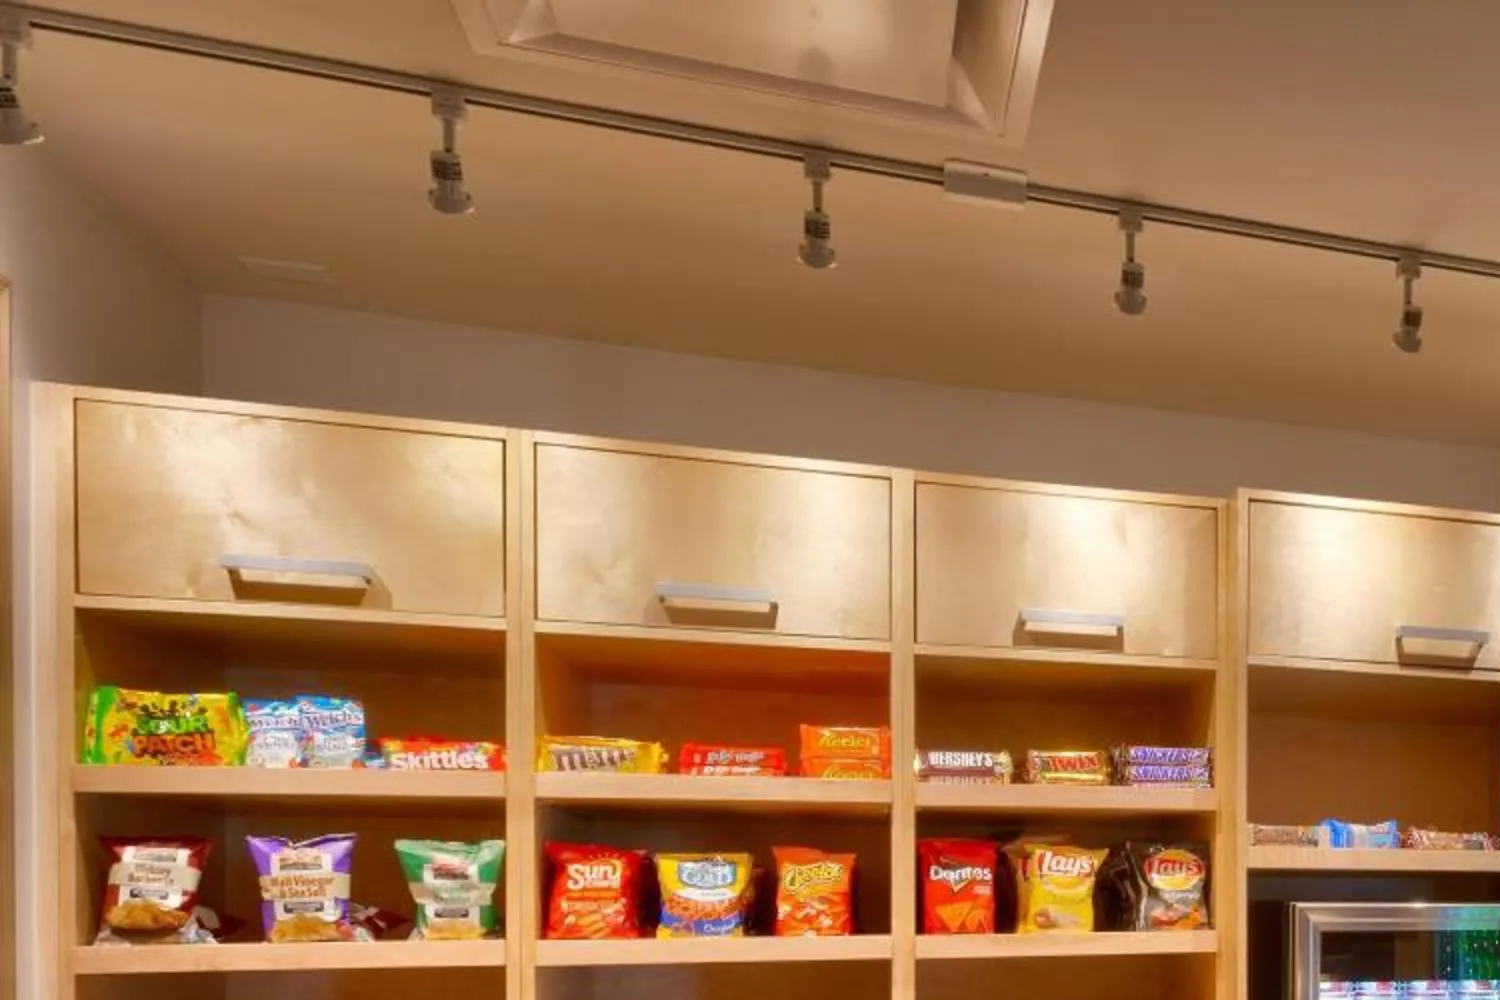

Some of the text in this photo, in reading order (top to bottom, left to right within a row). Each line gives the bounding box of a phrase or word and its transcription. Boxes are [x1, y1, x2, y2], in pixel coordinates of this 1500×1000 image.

[391, 750, 490, 770] Skittles
[929, 751, 992, 767] HERSHEY'S
[566, 863, 620, 891] Sun
[929, 865, 992, 882] Doritos
